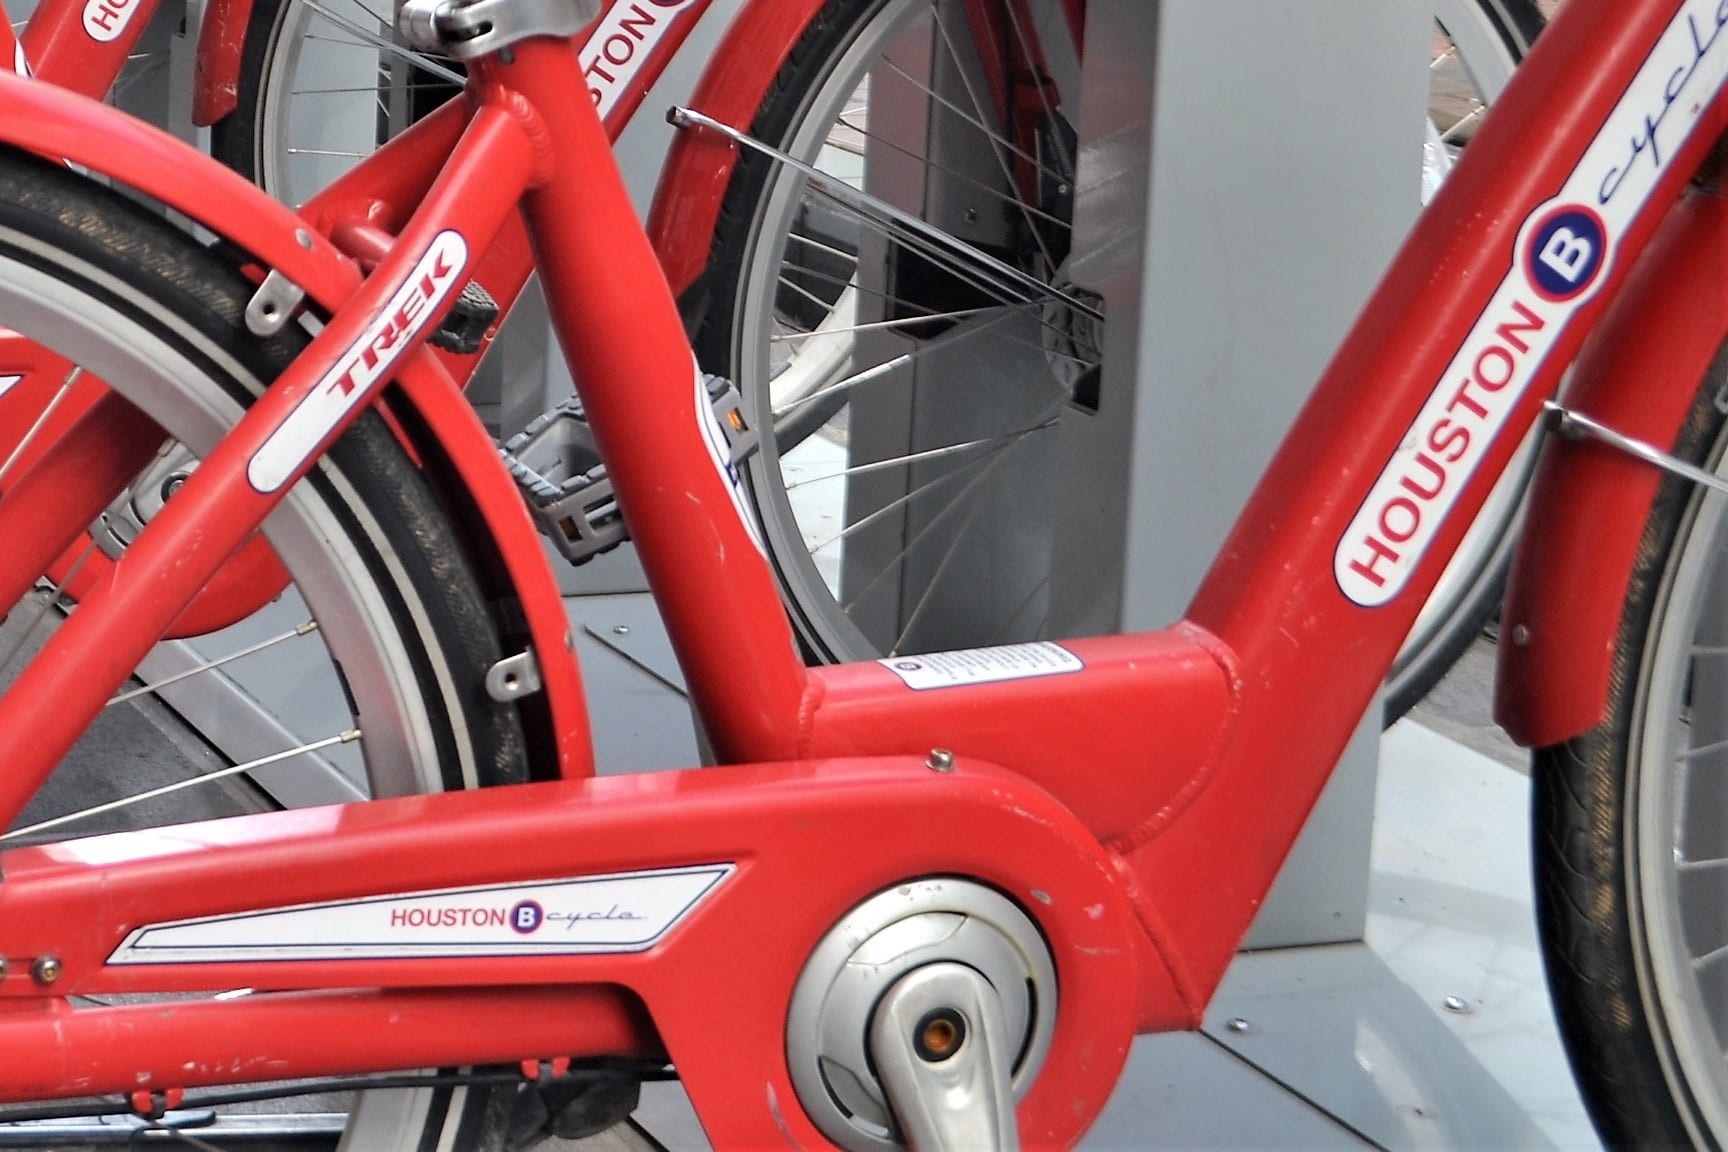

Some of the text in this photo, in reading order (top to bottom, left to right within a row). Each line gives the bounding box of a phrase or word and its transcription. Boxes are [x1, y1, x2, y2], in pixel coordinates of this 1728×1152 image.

[325, 247, 454, 398] TREK
[1349, 298, 1547, 589] HOUSTON
[390, 907, 506, 927] HOUSTON
[545, 903, 645, 930] cycle
